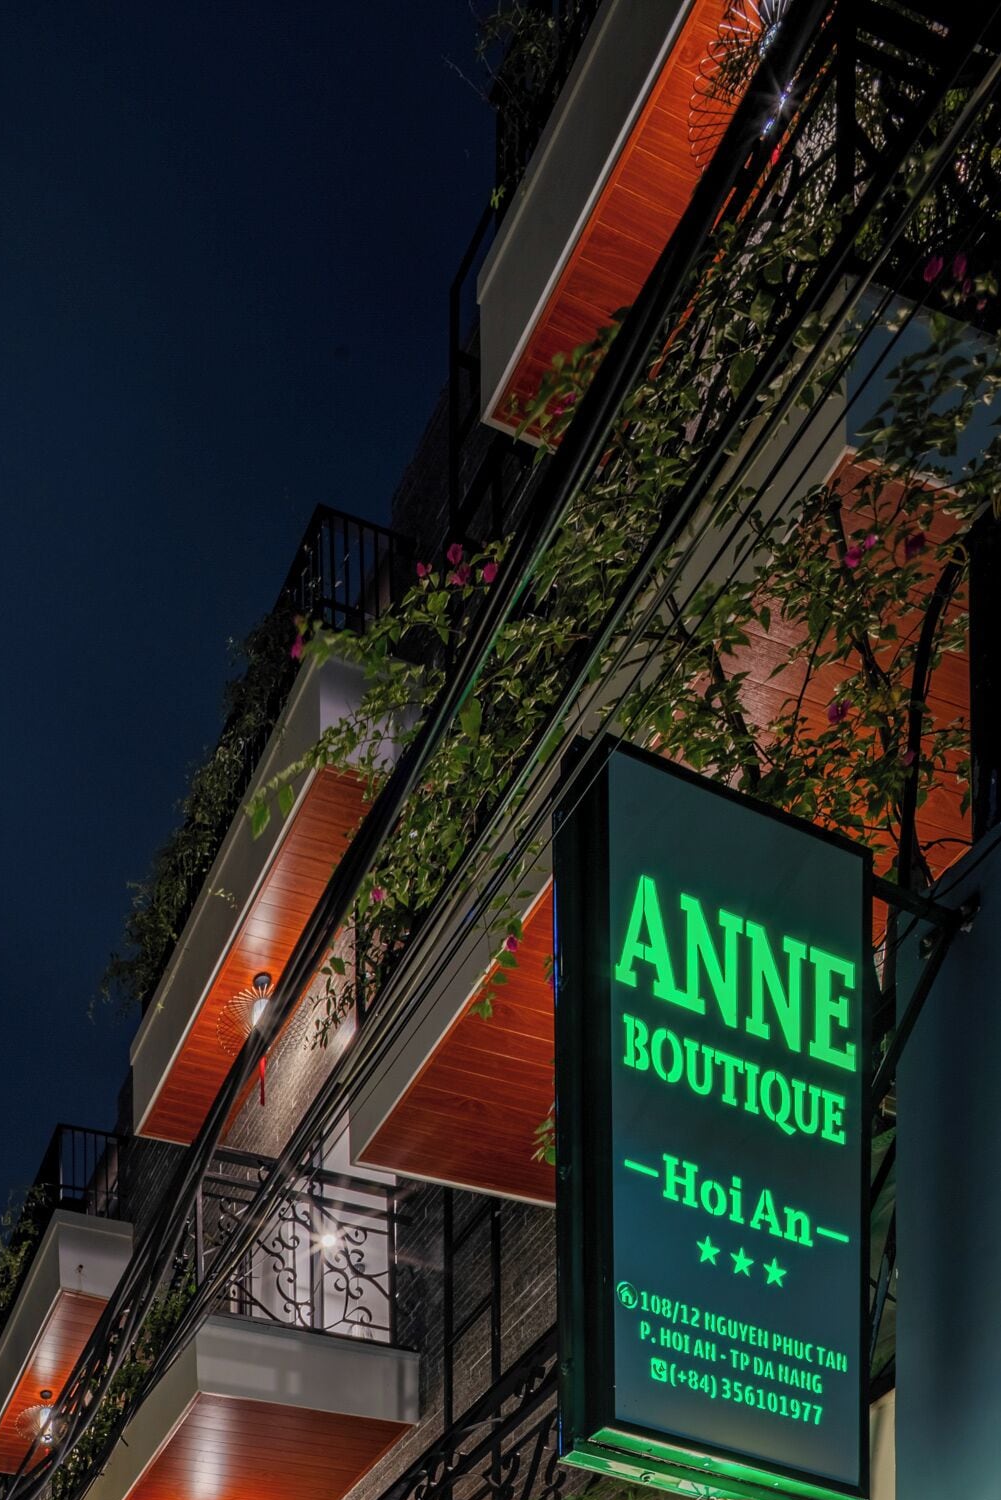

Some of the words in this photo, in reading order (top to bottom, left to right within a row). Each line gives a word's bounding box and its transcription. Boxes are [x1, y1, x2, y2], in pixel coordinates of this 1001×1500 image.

[615, 874, 856, 1072] ANNE
[623, 1013, 846, 1145] BOUTIQUE
[640, 1291, 700, 1327] 108/12
[704, 1312, 769, 1349] NGUYEN
[772, 1333, 813, 1363] PHUC
[816, 1346, 848, 1373] TAN
[640, 1320, 657, 1344] P.
[660, 1327, 691, 1356] HOI
[693, 1338, 717, 1362] AN
[730, 1349, 750, 1371] TP
[753, 1356, 775, 1381] DA
[778, 1363, 823, 1394] NANG
[670, 1363, 718, 1399] (+84)
[721, 1377, 823, 1425] 356101977
